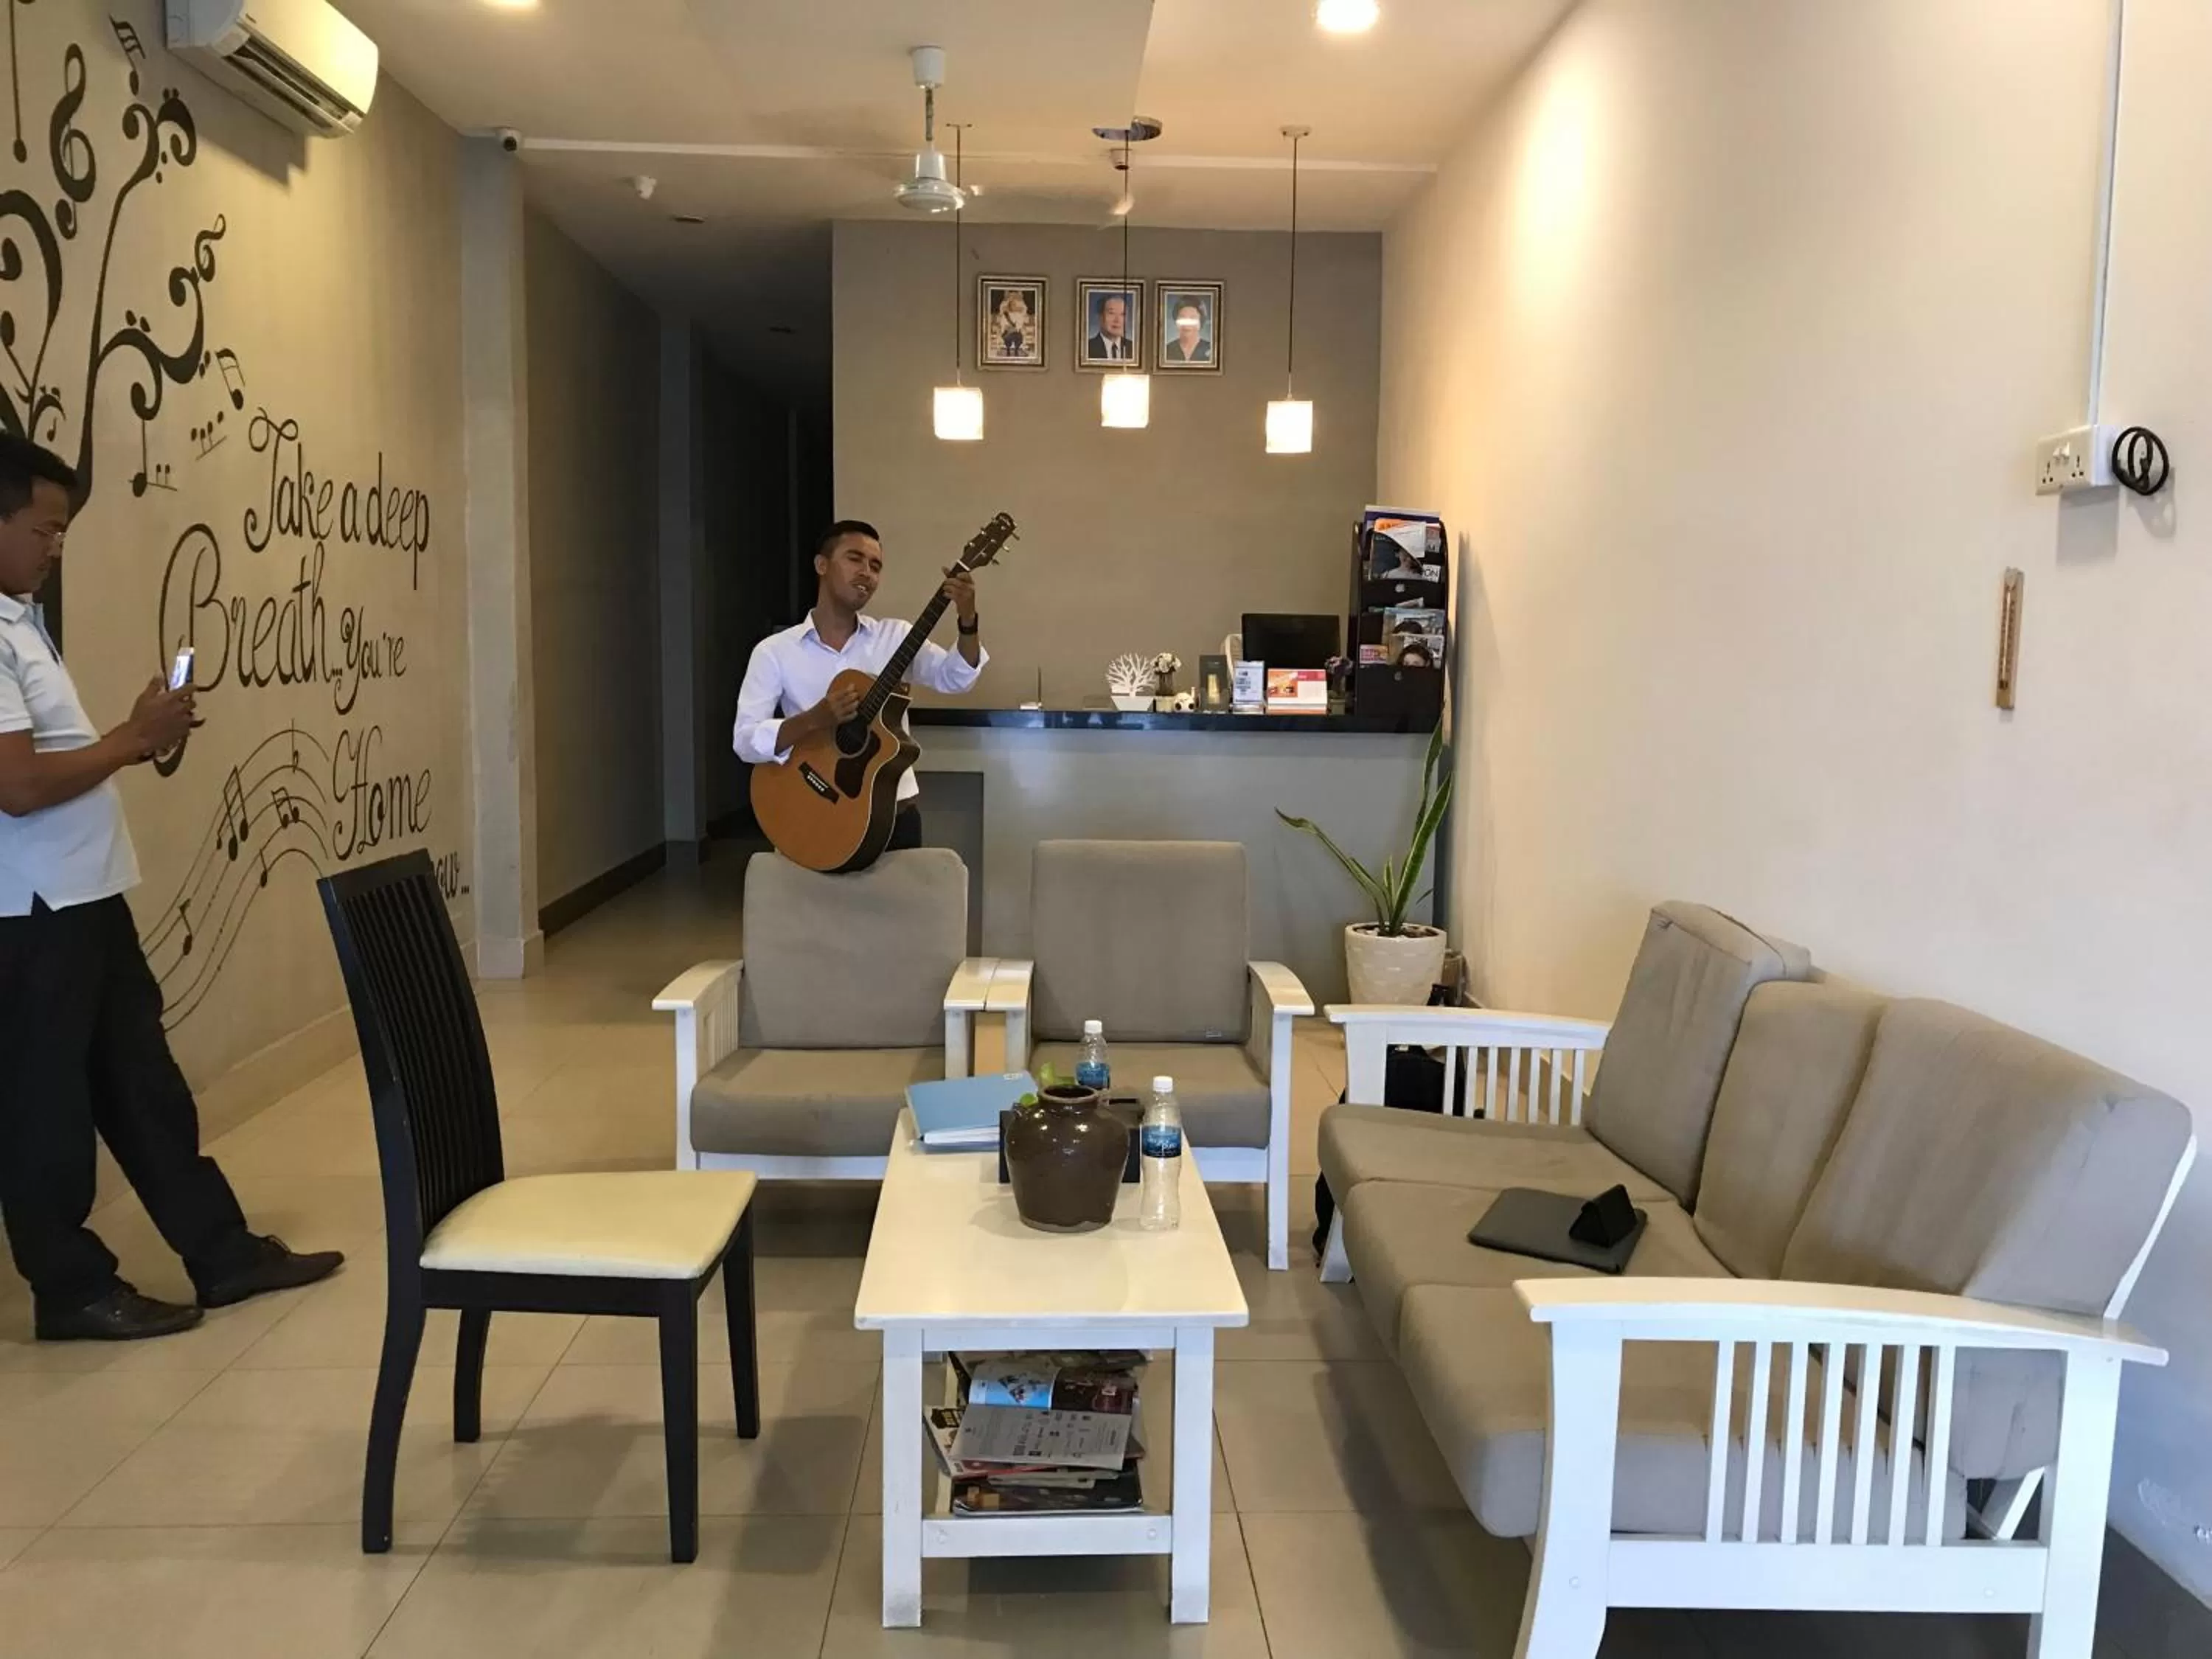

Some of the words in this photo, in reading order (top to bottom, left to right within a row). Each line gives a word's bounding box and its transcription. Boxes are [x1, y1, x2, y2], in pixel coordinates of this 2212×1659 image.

[244, 407, 334, 553] Take
[340, 481, 361, 543] a
[366, 451, 430, 591] deep
[333, 725, 432, 860] Home
